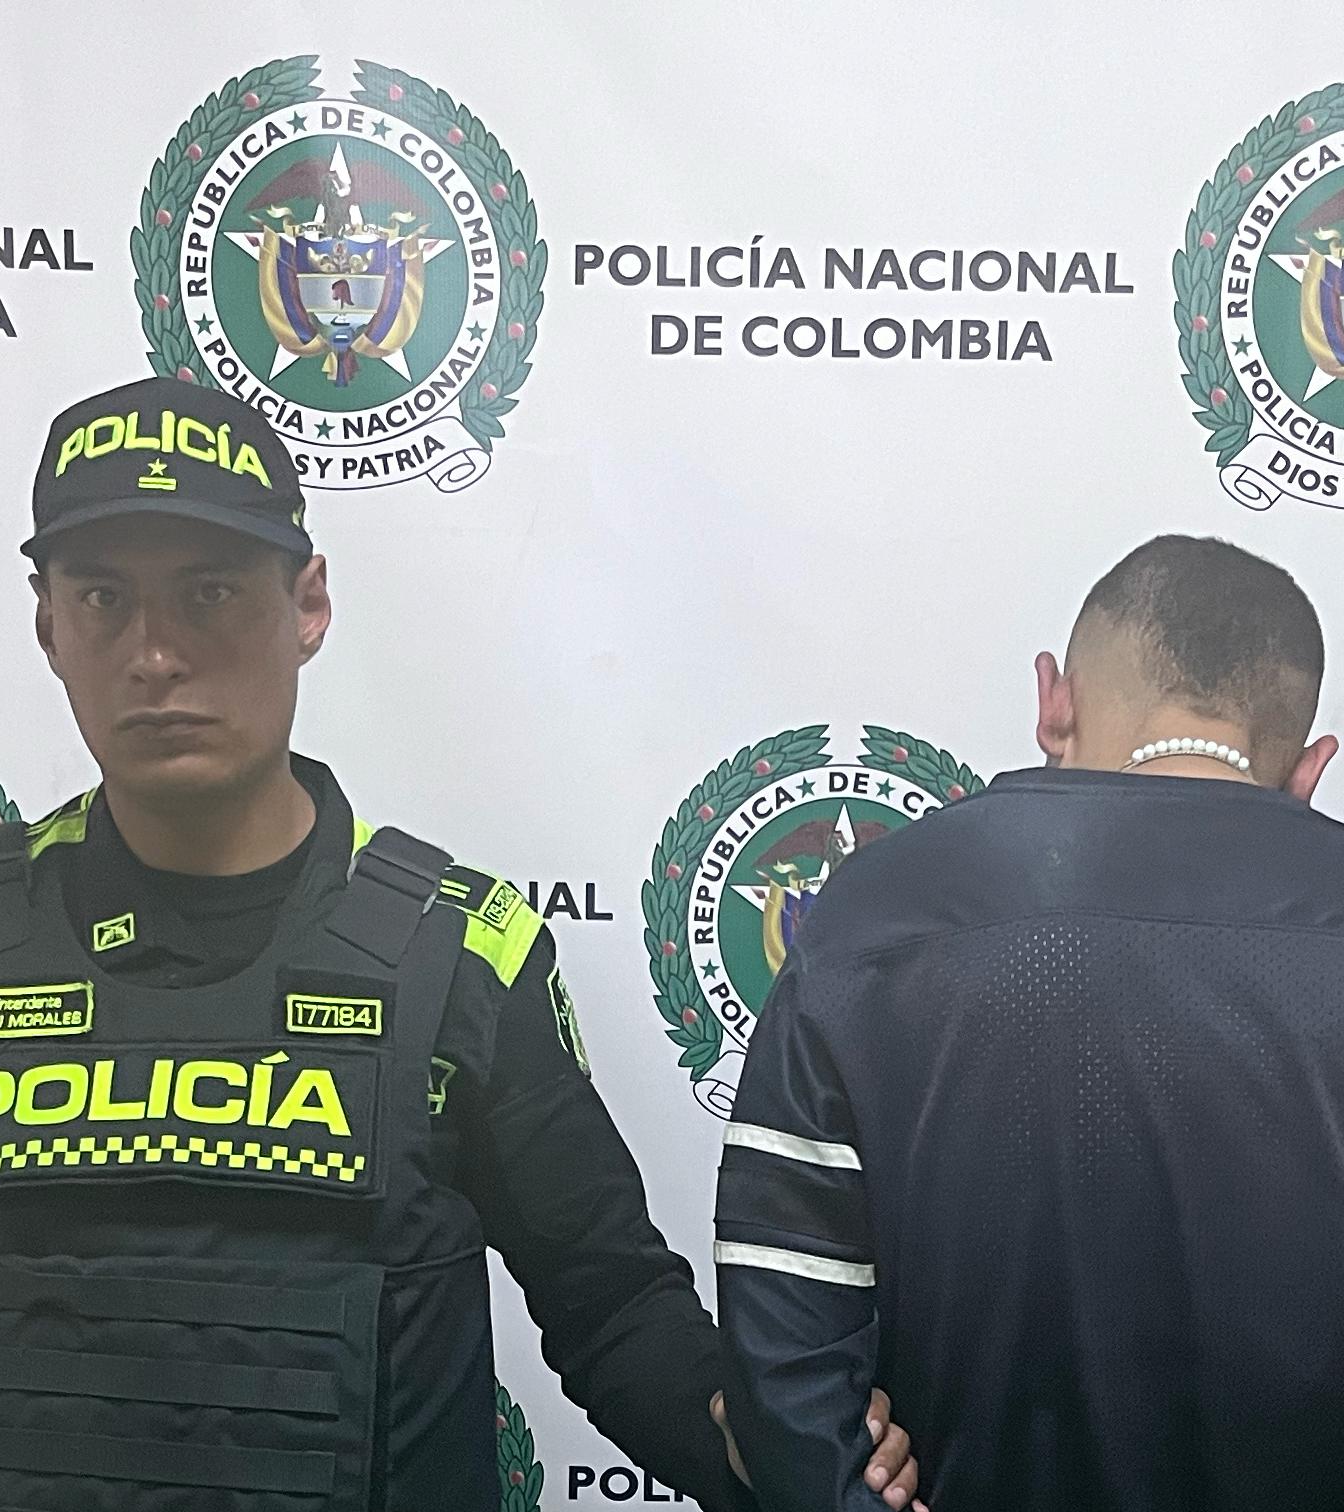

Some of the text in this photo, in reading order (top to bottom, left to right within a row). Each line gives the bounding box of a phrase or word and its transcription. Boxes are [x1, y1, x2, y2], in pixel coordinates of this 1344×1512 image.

[320, 109, 365, 135] DE
[399, 131, 495, 306] COLOMBIA
[575, 235, 1134, 293] POLICÍA NACIONAL
[652, 315, 1052, 361] DE COLOMBIA
[342, 344, 480, 439] NACIONAL
[54, 410, 273, 489] POLICÍA
[342, 435, 445, 480] PATRIA
[828, 771, 870, 795] DE
[295, 1003, 372, 1027] 177184
